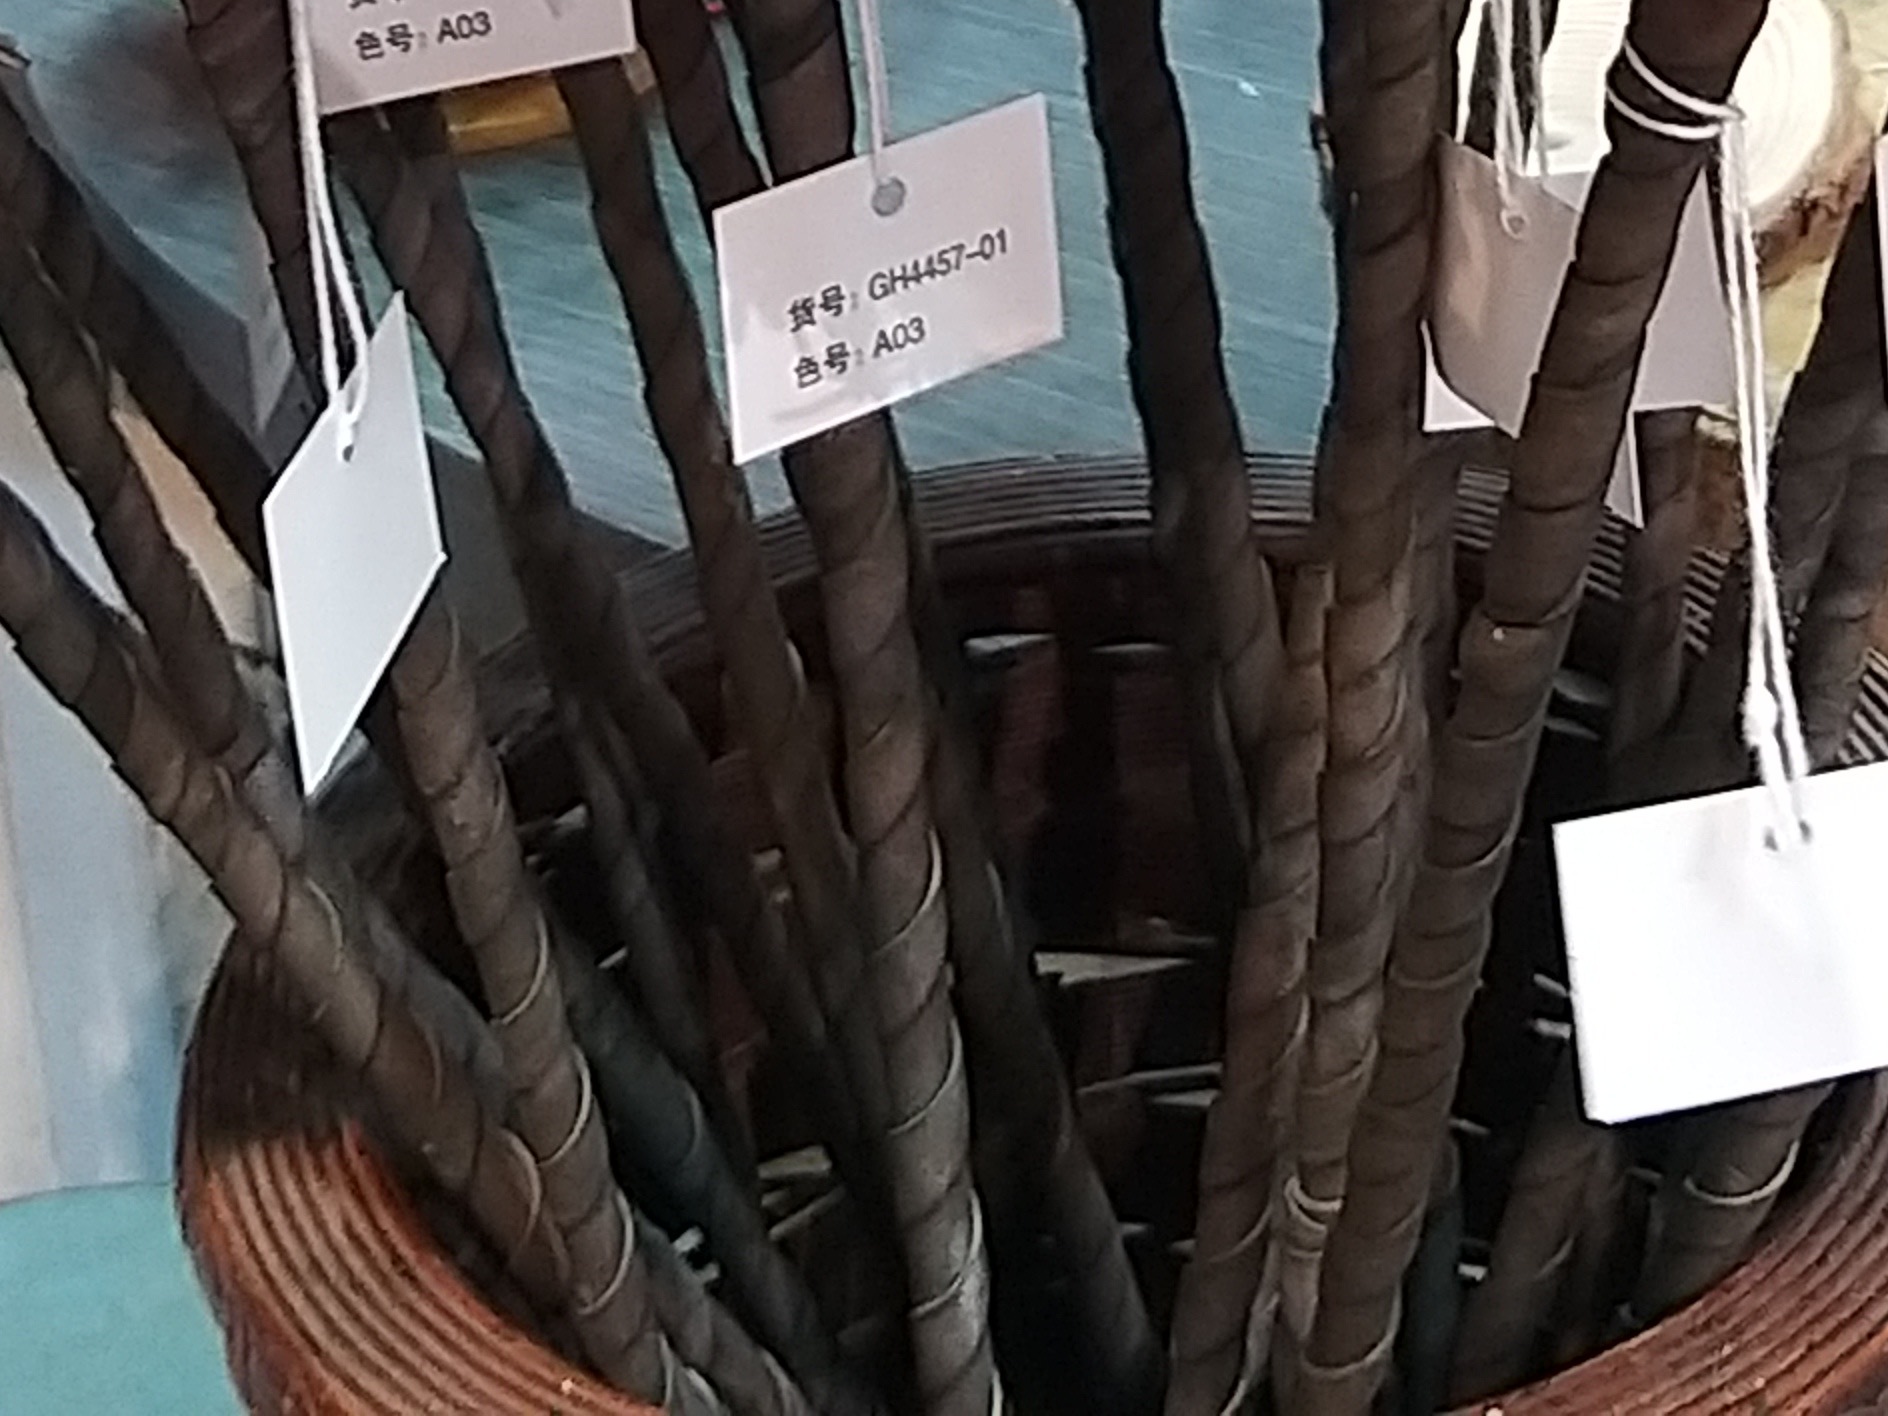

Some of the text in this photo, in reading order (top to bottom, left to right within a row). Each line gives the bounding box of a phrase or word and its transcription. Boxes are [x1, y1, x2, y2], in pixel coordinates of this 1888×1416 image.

[436, 10, 493, 44] A03
[868, 228, 1008, 302] GH4457-01
[872, 317, 927, 359] A03
